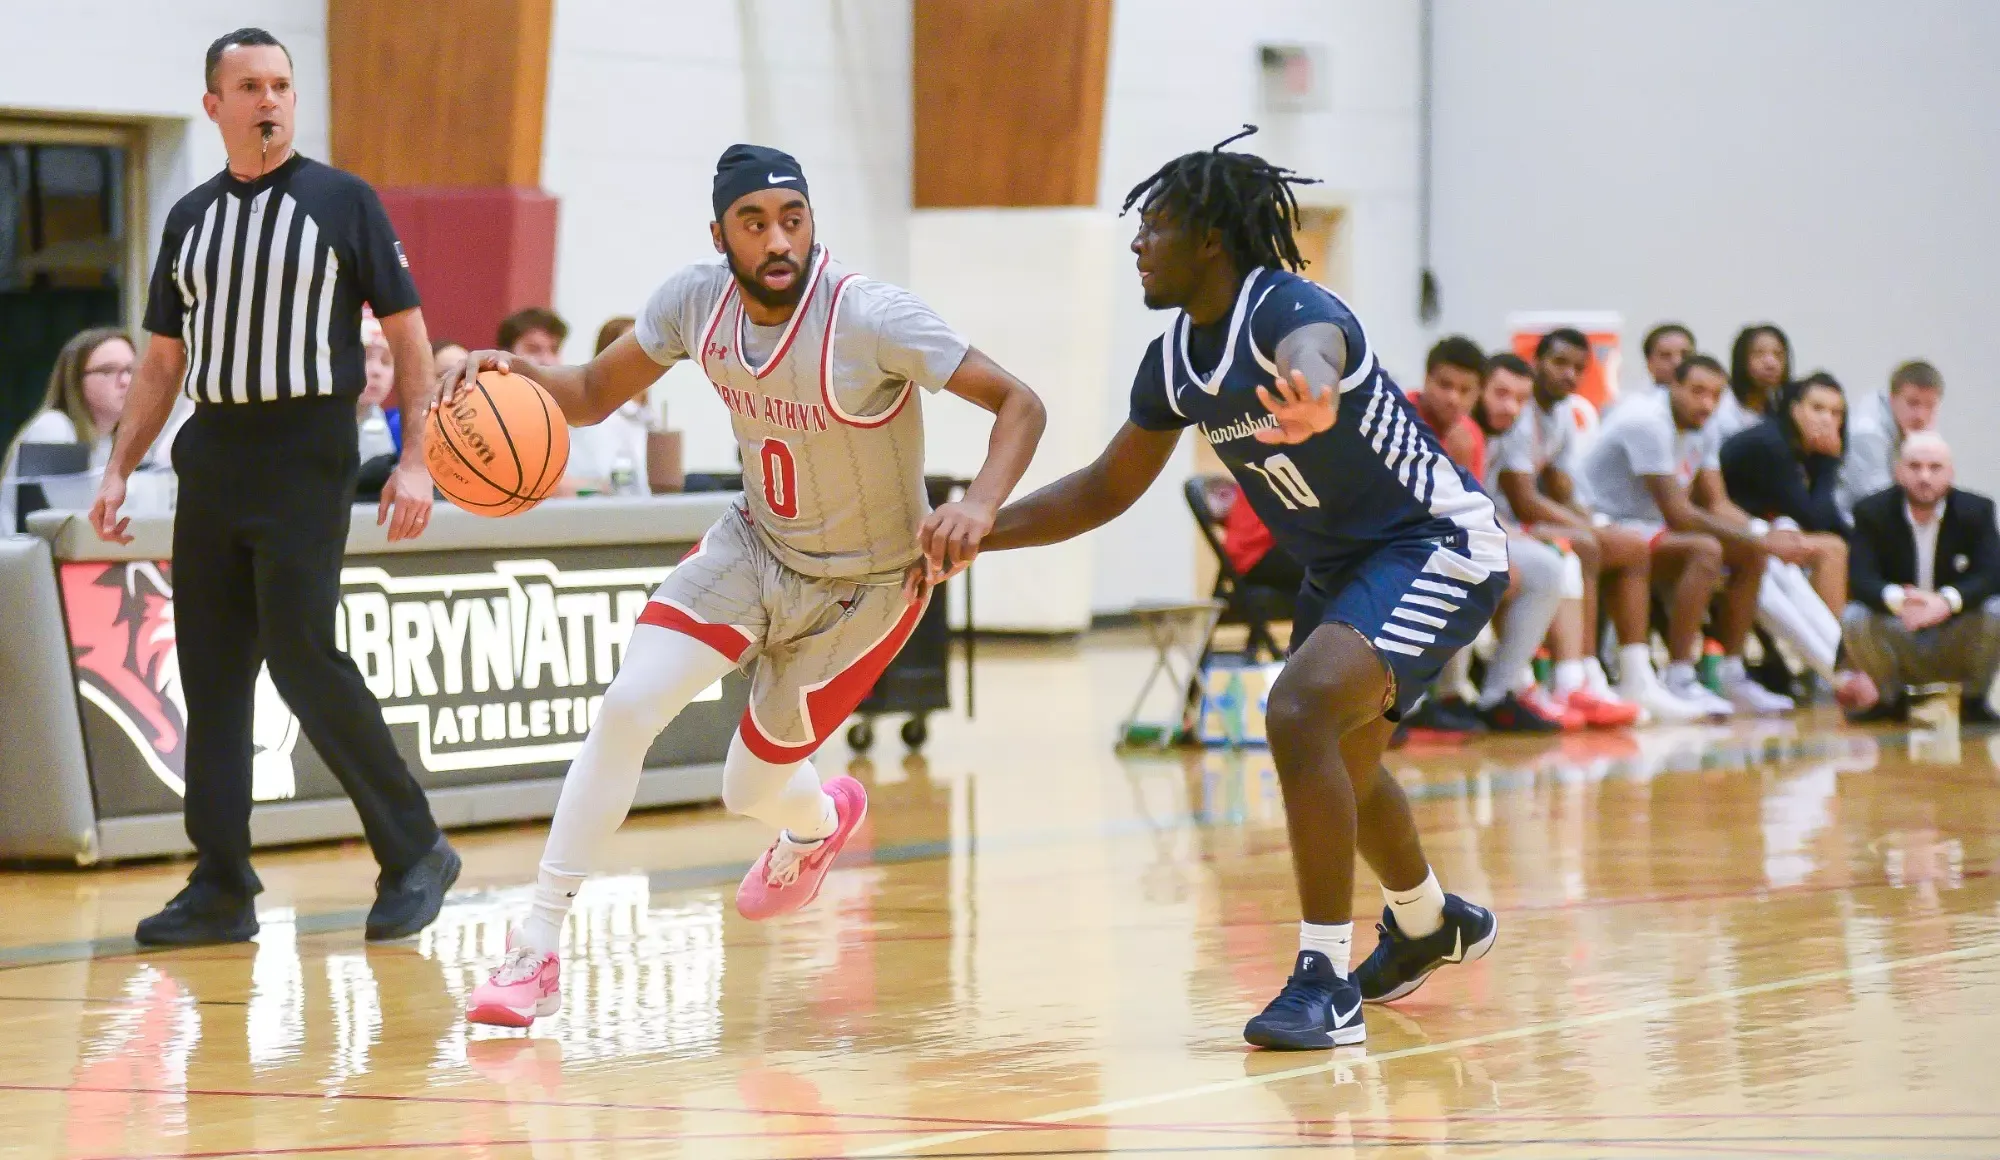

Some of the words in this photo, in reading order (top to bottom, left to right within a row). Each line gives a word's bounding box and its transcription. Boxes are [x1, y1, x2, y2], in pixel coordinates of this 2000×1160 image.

[763, 394, 828, 432] ATHYN
[1201, 411, 1280, 445] arrisbur
[761, 436, 799, 520] 0
[1244, 452, 1320, 510] 10
[343, 591, 515, 699] BRYN
[522, 582, 648, 689] ATH
